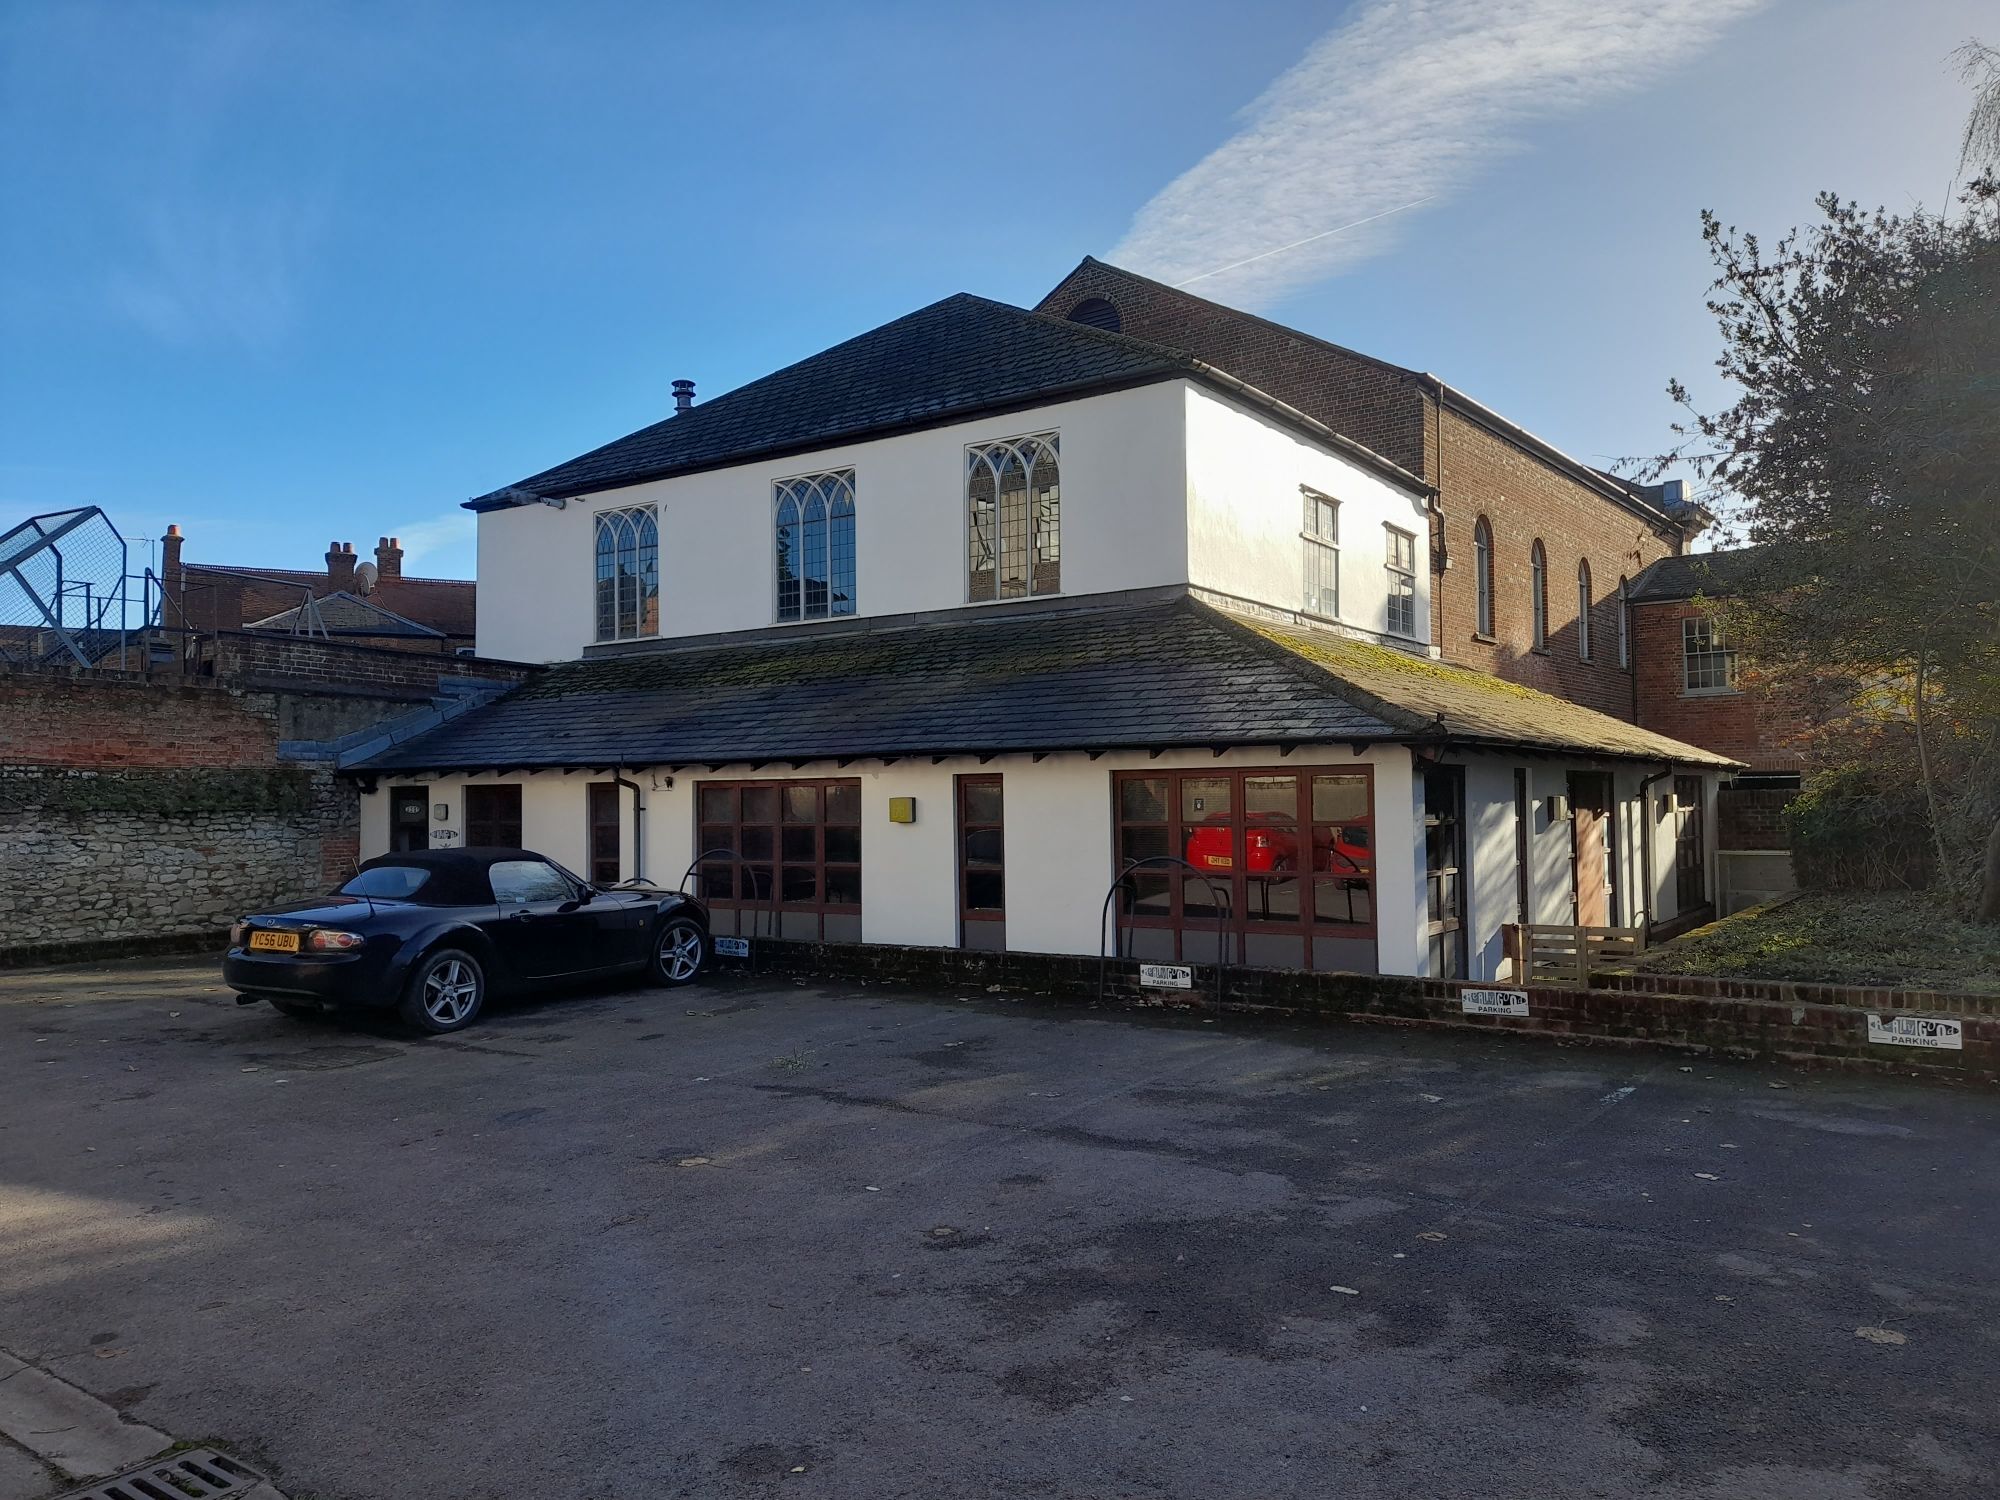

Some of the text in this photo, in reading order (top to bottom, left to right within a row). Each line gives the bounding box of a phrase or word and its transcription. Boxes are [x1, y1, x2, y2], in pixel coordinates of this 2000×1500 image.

[254, 933, 296, 948] YC56 UBU
[1152, 979, 1178, 987] PARKING
[1478, 1006, 1511, 1014] PARKING
[1892, 1036, 1938, 1046] PARKING
